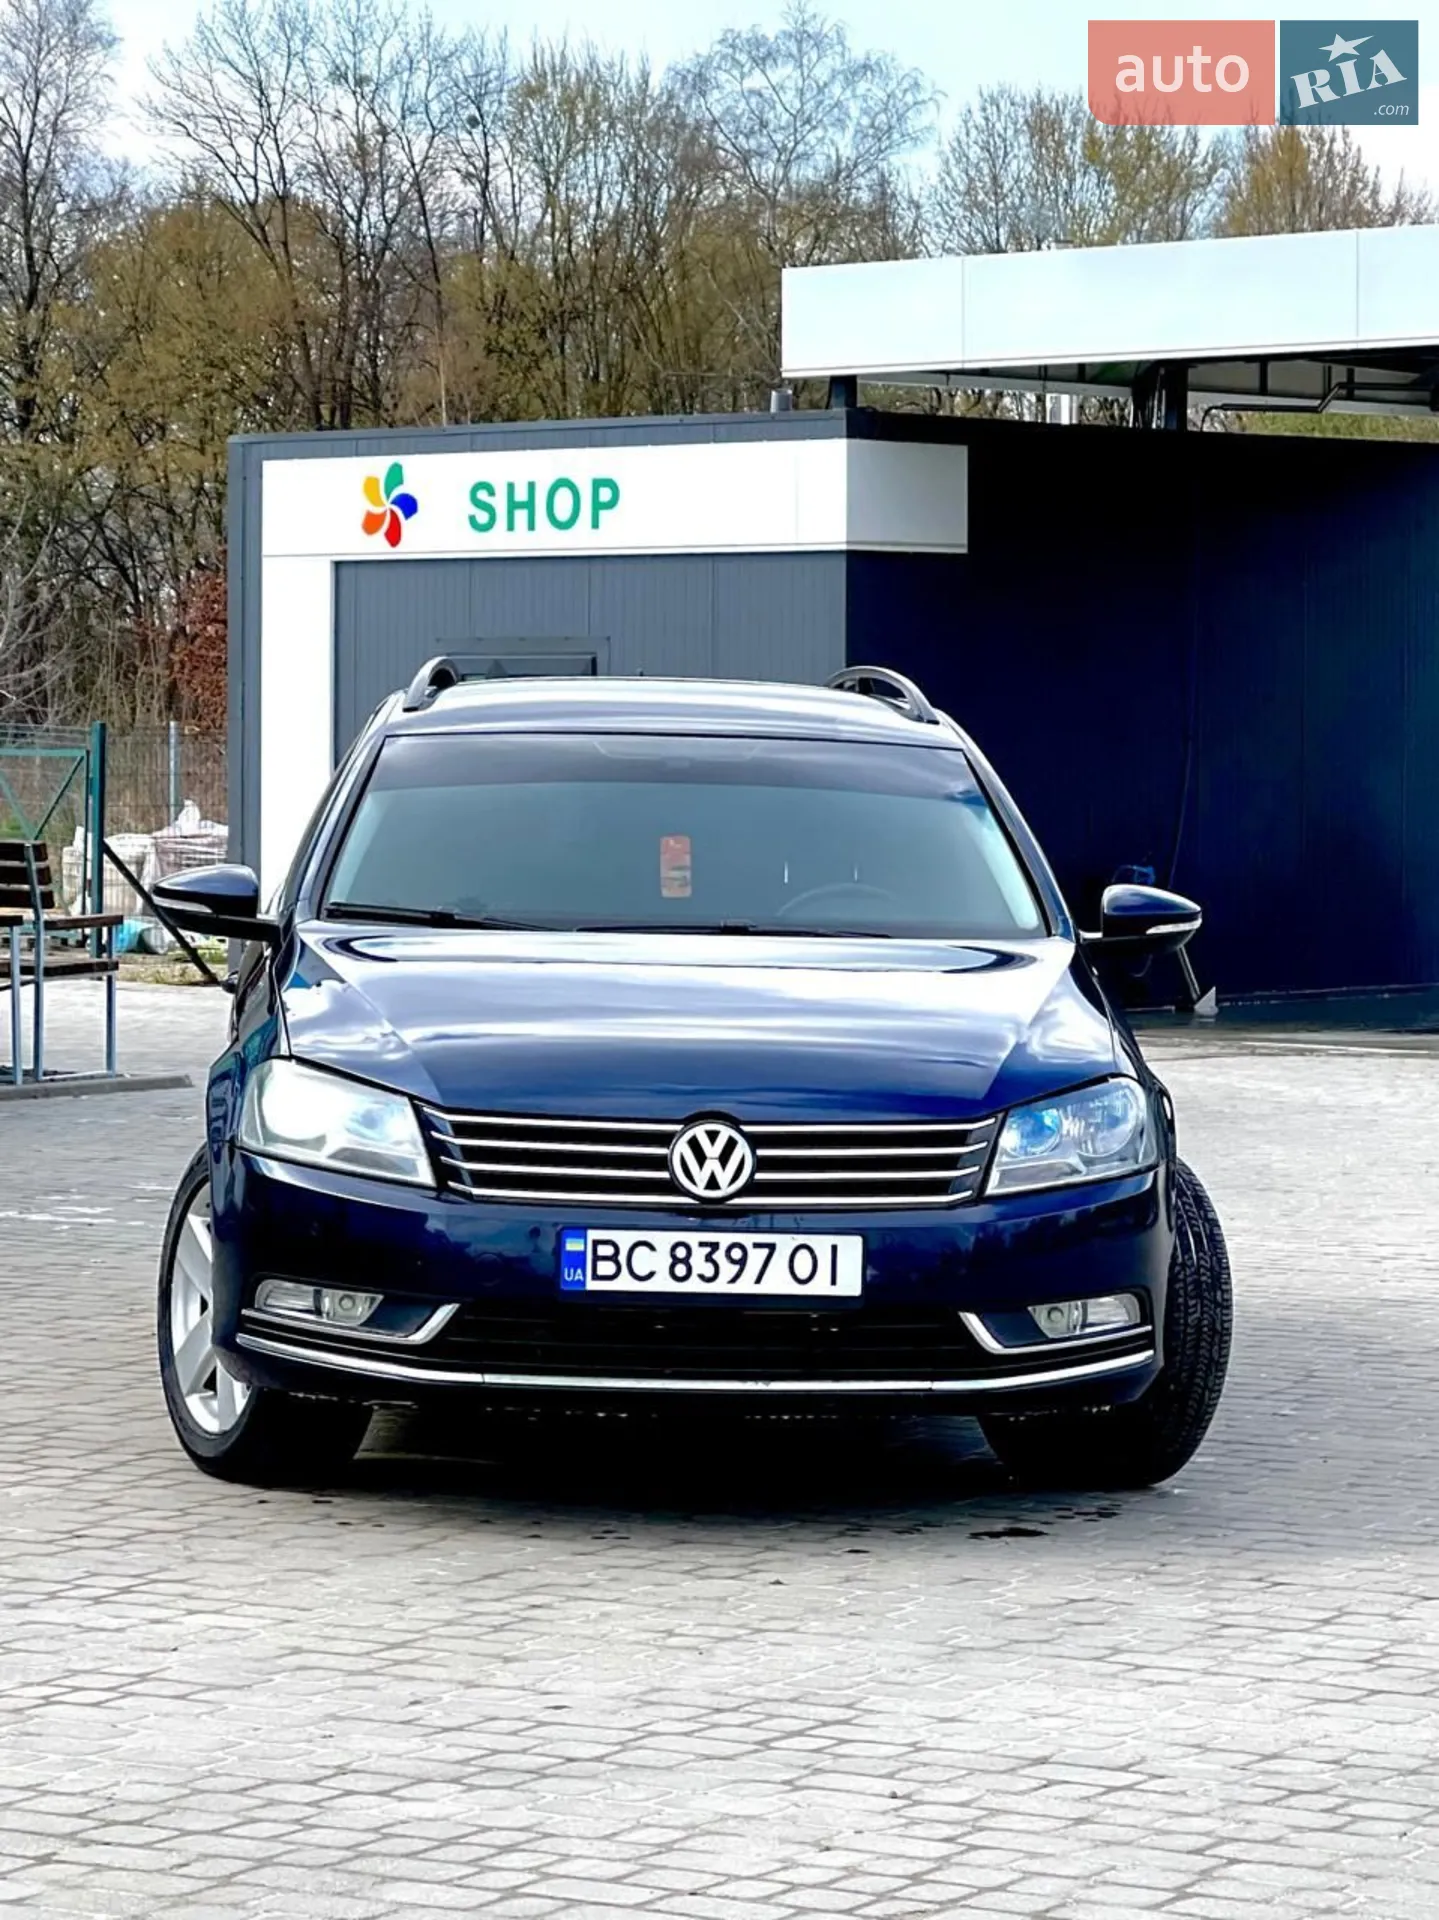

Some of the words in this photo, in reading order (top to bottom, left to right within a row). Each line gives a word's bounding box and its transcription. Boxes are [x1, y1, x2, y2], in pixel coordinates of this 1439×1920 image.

[468, 477, 620, 533] SHOP
[564, 1267, 584, 1281] UA
[591, 1239, 656, 1282] BC
[669, 1240, 777, 1286] 8397
